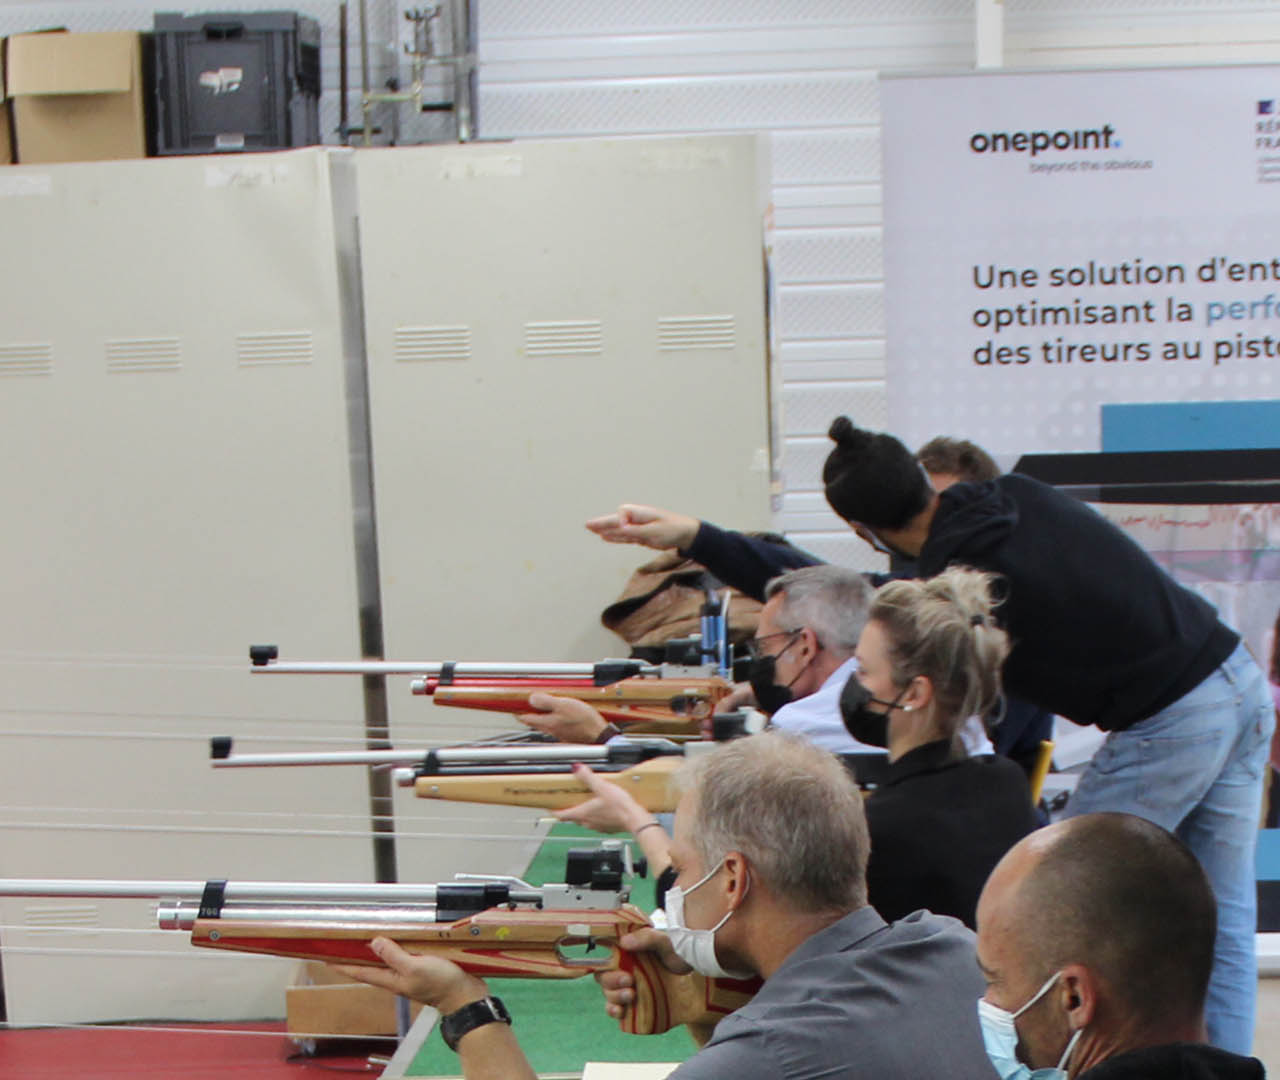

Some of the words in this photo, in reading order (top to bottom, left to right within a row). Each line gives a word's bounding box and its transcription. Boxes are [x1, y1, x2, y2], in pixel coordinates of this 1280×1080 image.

[972, 264, 1039, 290] Une
[1049, 258, 1185, 287] solution
[972, 299, 1156, 333] optimisant
[1167, 297, 1193, 323] la
[972, 340, 1032, 366] des
[1041, 337, 1151, 364] tireurs
[1162, 340, 1202, 361] au
